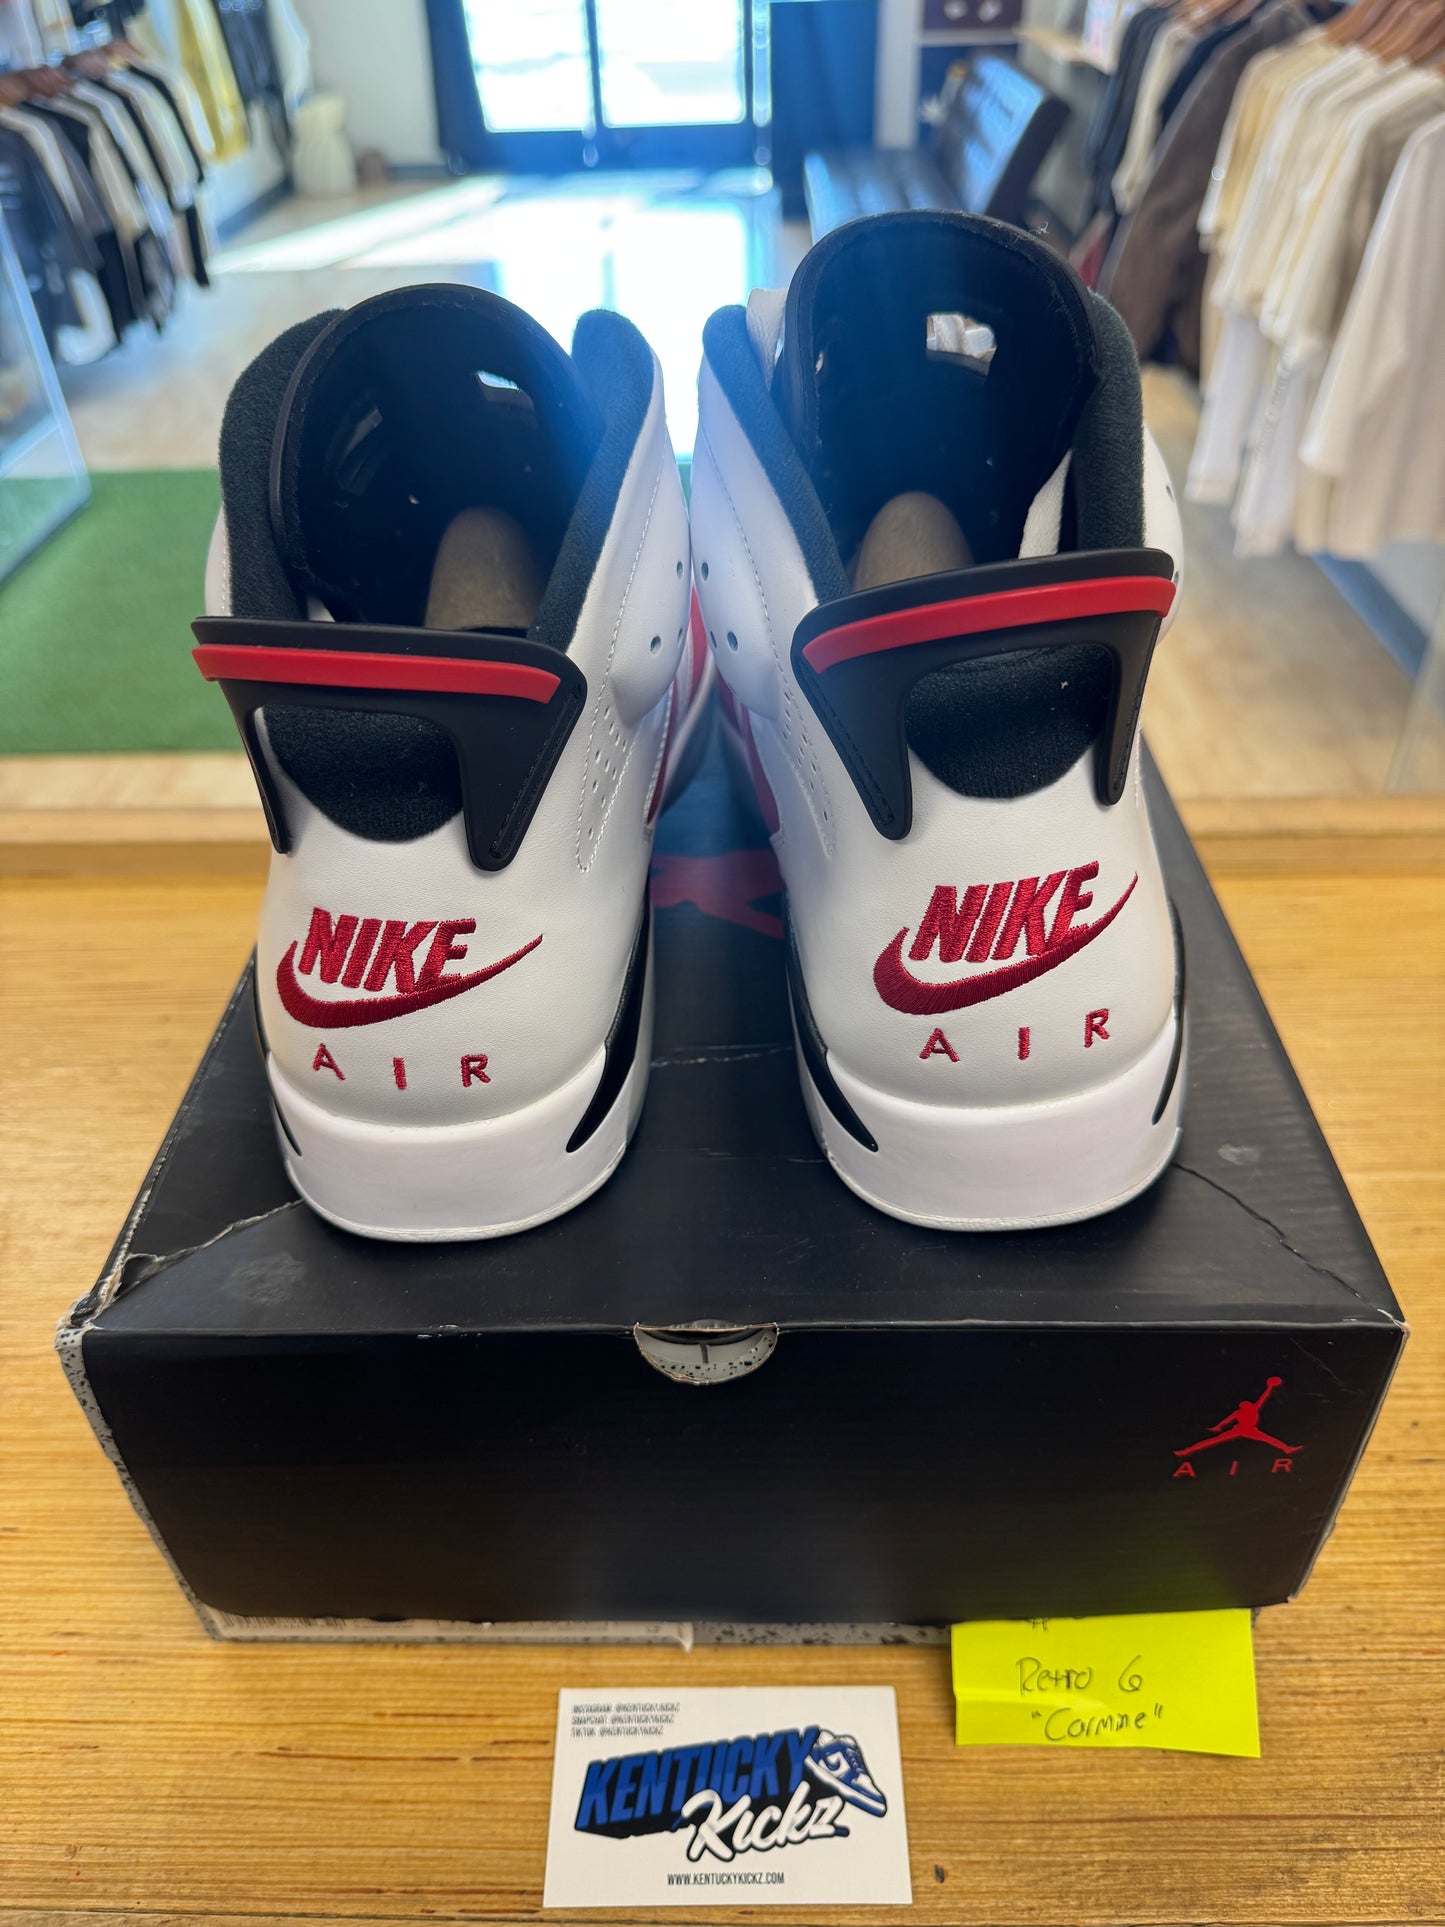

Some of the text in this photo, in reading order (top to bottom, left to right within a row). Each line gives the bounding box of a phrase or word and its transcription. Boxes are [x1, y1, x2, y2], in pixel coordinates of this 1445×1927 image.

[908, 860, 1100, 963] NIKE
[298, 906, 477, 994] NIKE
[919, 1008, 1111, 1063] AIR
[312, 1042, 492, 1091] AIR
[1171, 1458, 1294, 1478] AIR
[1015, 1654, 1143, 1696] Retro 6
[575, 1726, 820, 1834] KENTUCKY
[681, 1780, 845, 1862] Kickz
[667, 1871, 785, 1886] WWW.KENTUCKYKICKZ.COM
